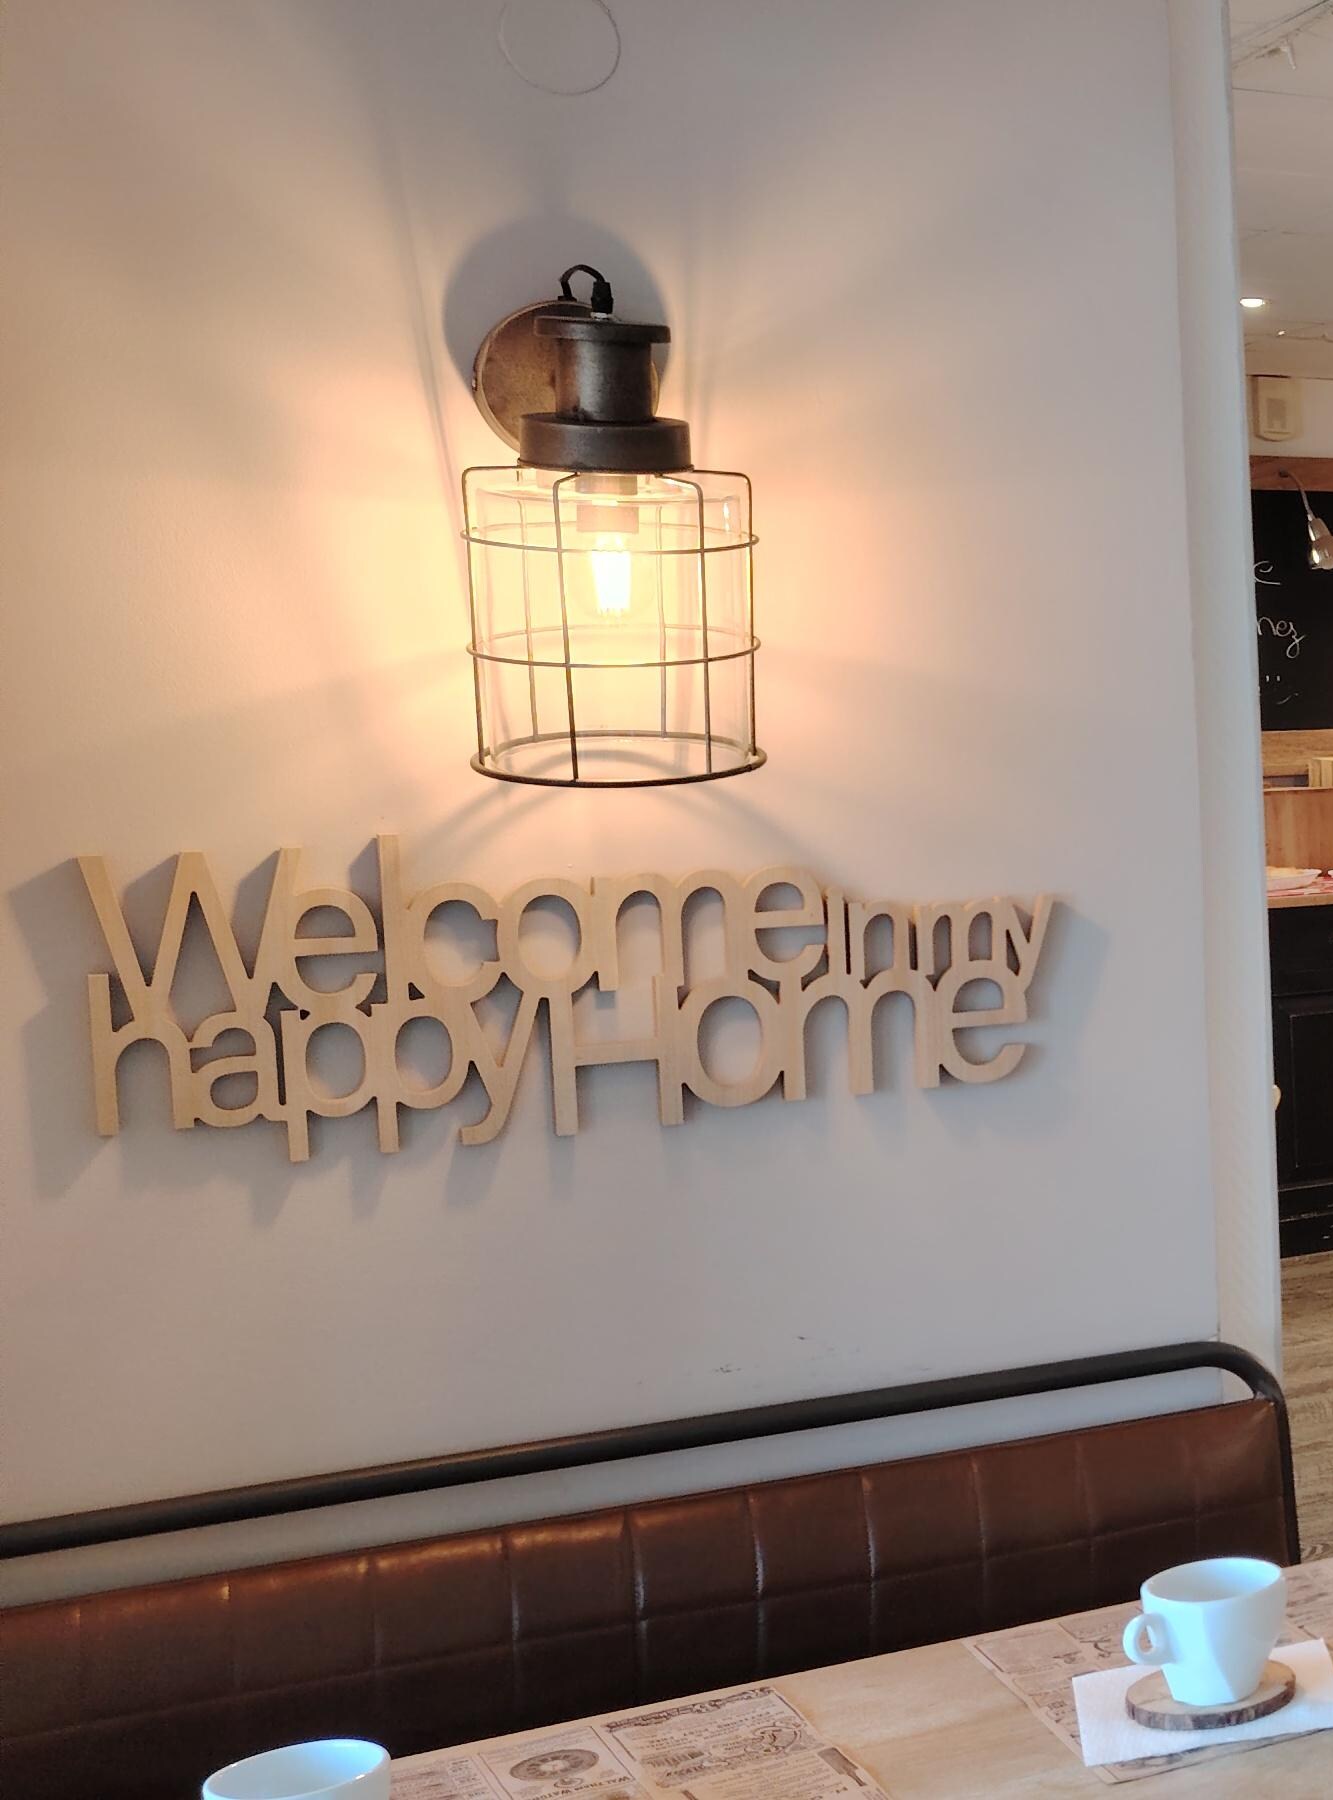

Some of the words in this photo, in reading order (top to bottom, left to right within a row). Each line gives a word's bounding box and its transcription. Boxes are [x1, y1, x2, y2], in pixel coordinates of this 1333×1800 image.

[77, 834, 826, 1004] Welcome
[914, 888, 1056, 992] my
[88, 972, 546, 1162] happy
[546, 966, 1028, 1136] Home
